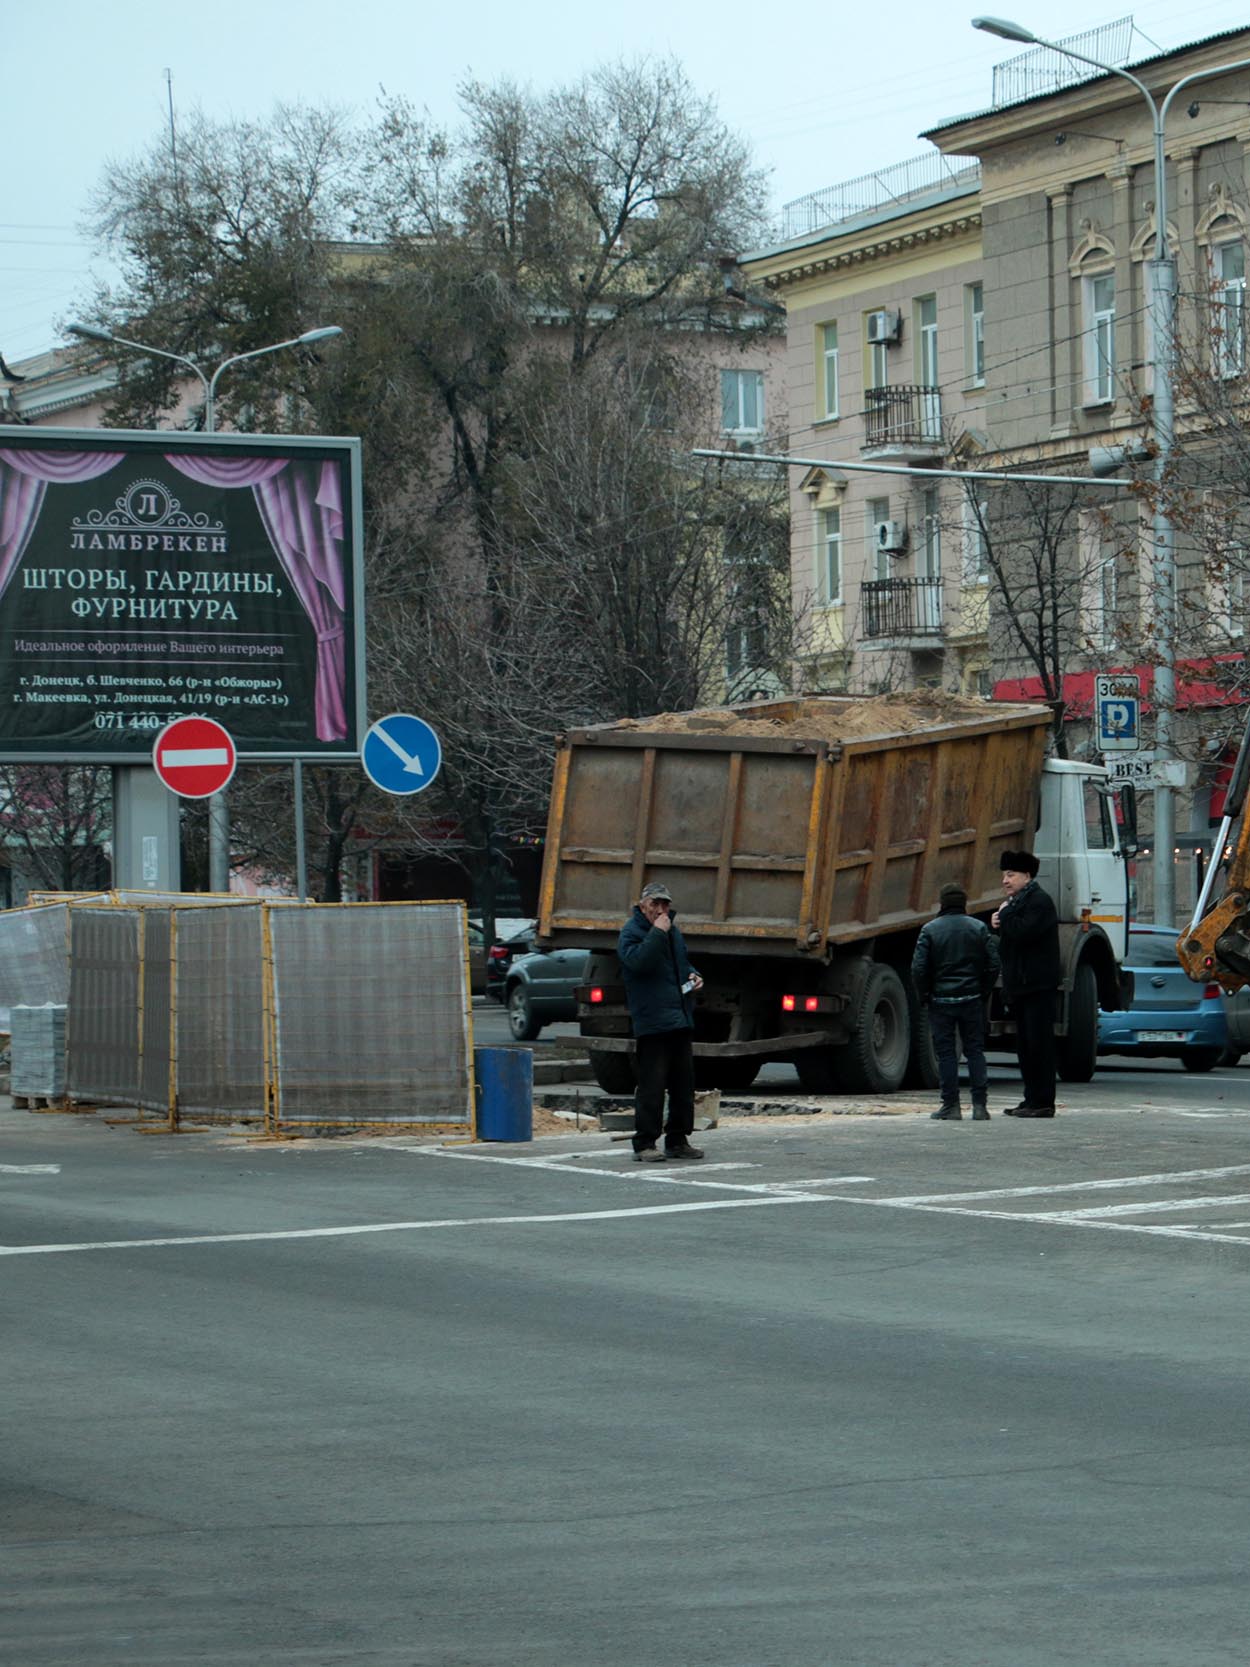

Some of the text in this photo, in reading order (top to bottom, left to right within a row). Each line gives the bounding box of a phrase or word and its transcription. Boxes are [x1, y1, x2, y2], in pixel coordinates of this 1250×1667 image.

[137, 494, 158, 516] Л
[70, 533, 227, 553] ЛАМБРЕКЕН
[22, 568, 282, 598] ШТОРЫ, ГАРДИНЫ,
[71, 597, 238, 620] ФУРНИТУРА
[14, 640, 284, 656] Идеальное оформление Вашего интерьера
[31, 675, 84, 687] Донецк,
[100, 675, 166, 688] Шевченко,
[168, 676, 184, 686] 66
[25, 692, 92, 703] Макеевка,
[113, 692, 177, 705] Донецкая,
[179, 693, 212, 705] 41/19
[95, 713, 125, 729] 071
[1115, 762, 1153, 777] BEST
